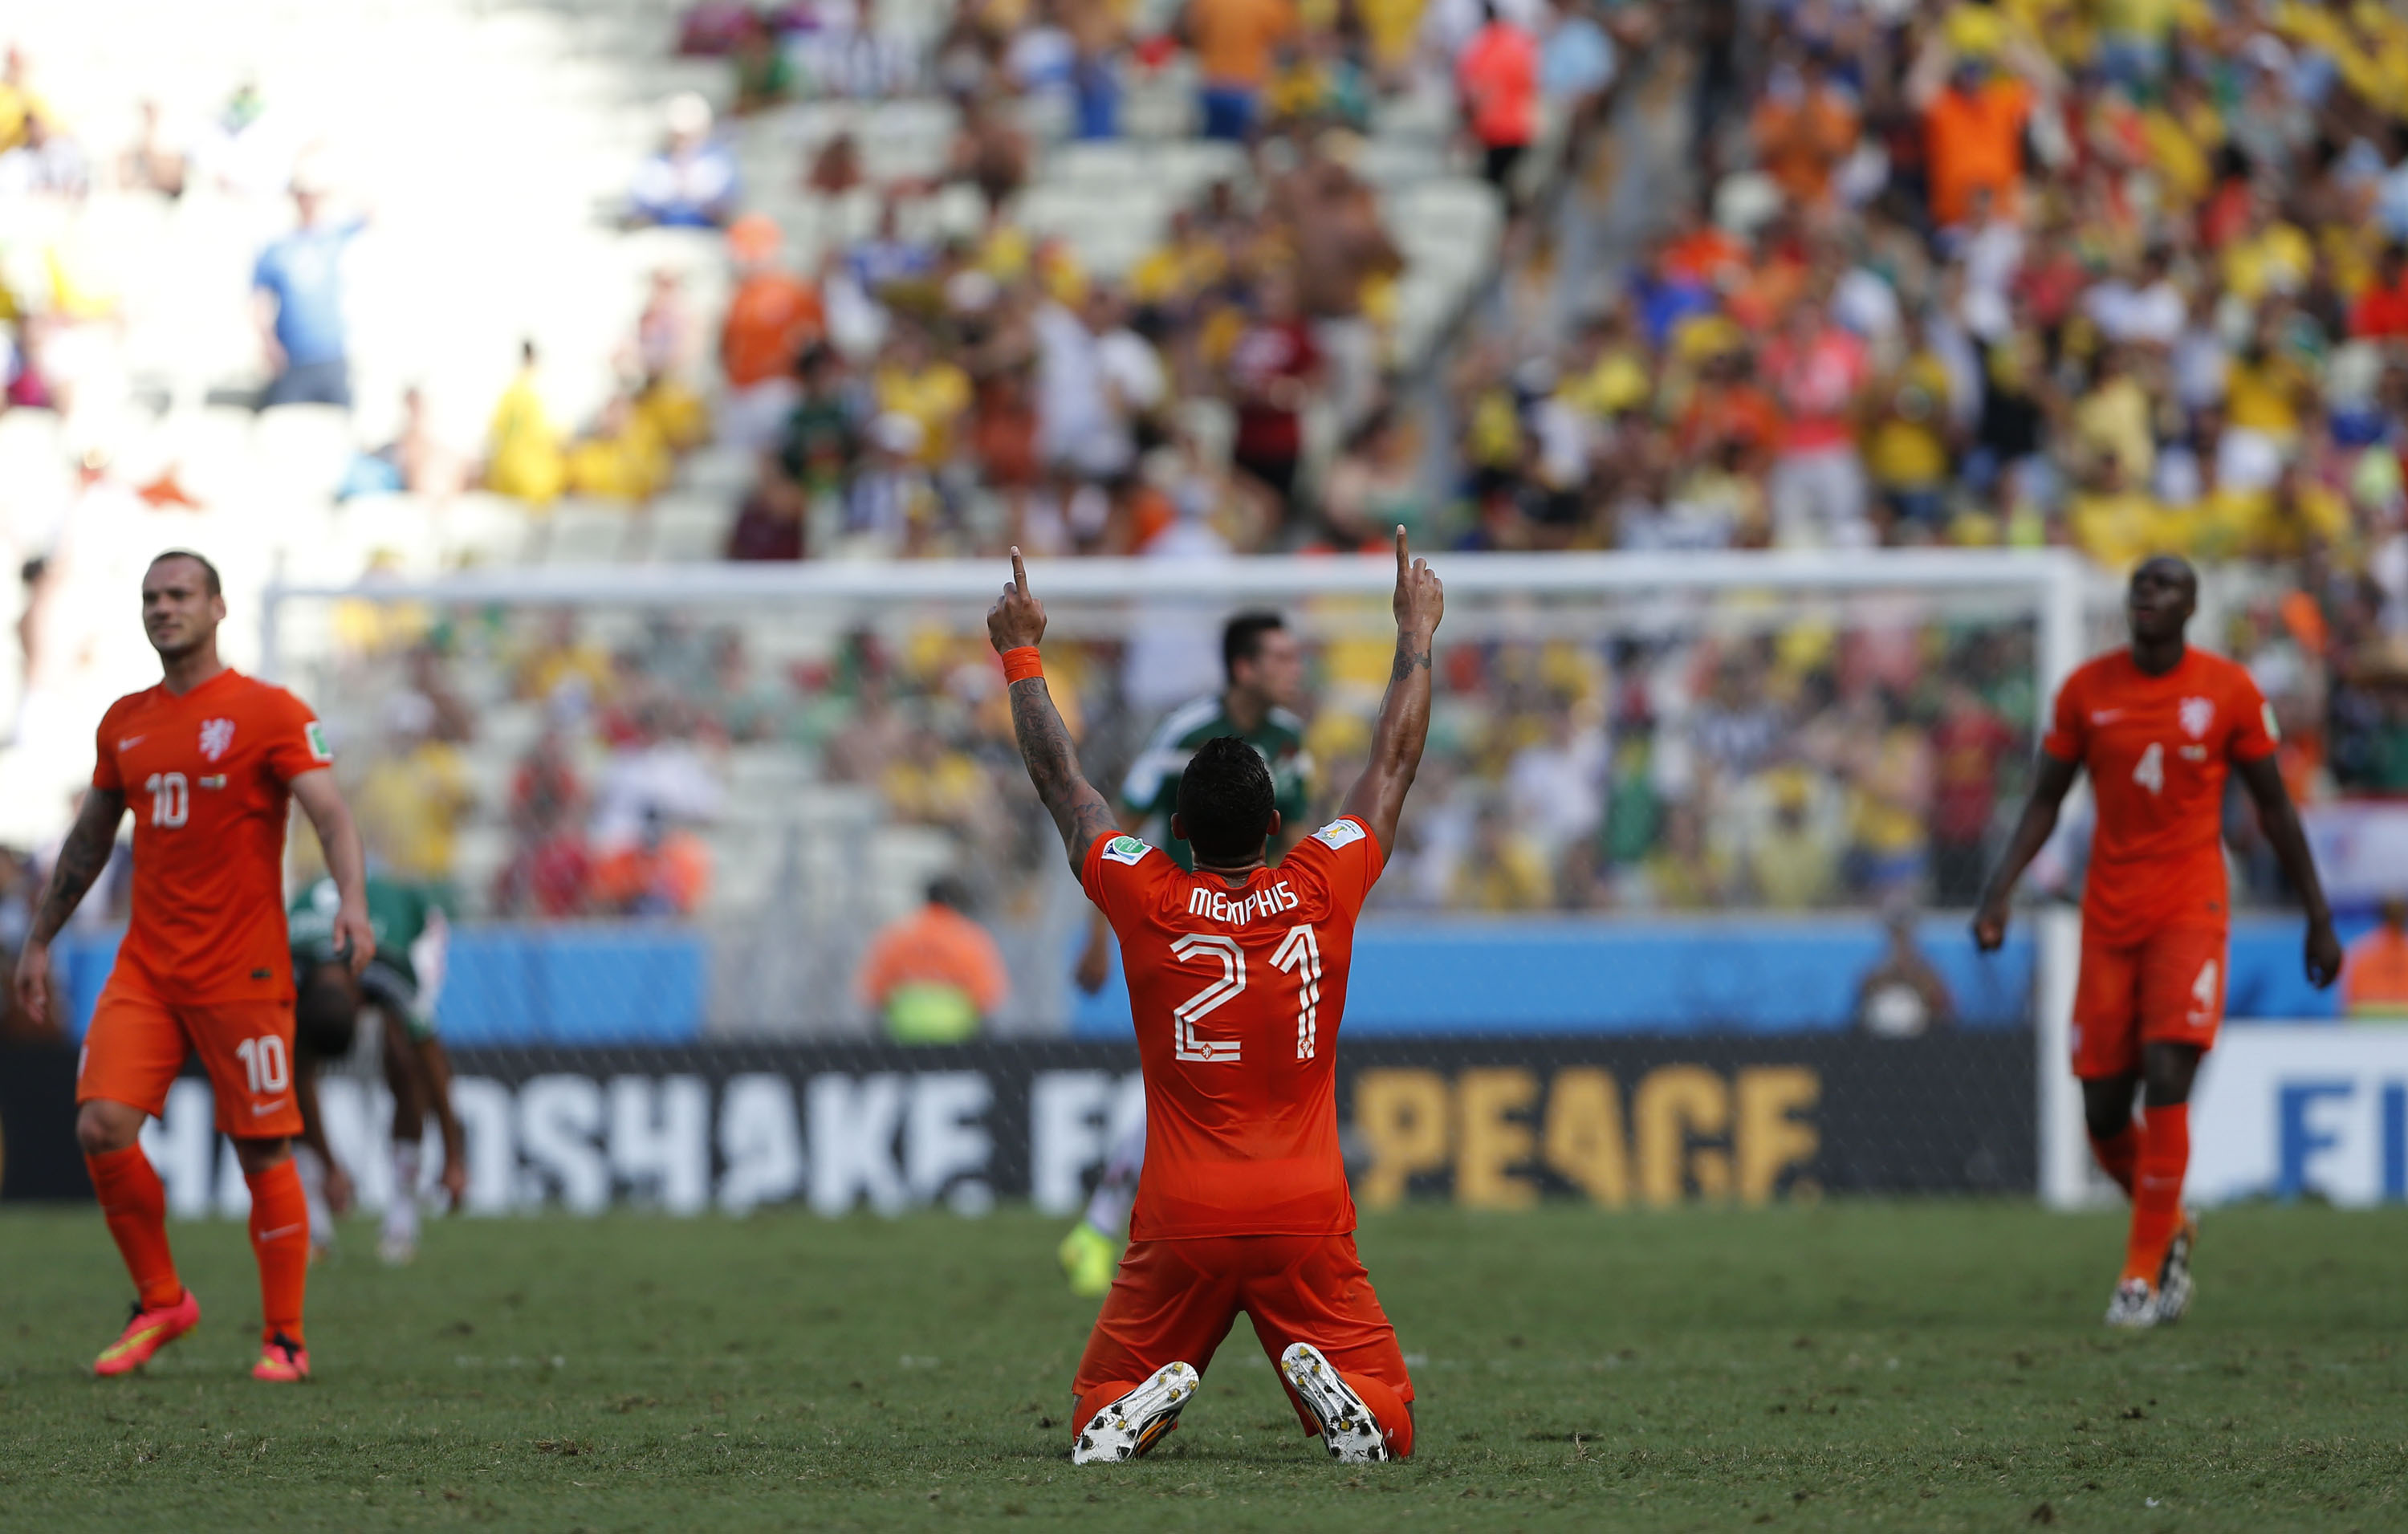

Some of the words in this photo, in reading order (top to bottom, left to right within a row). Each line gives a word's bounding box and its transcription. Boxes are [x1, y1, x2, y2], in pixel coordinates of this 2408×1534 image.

[2133, 742, 2163, 795] 4
[145, 771, 189, 828] 10
[1188, 881, 1299, 926] MEMPHIS
[1169, 923, 1323, 1061] 21
[2192, 958, 2217, 1009] 4
[236, 1035, 289, 1093] 10
[138, 1073, 995, 1218] HNDSHAKE
[1357, 1065, 1822, 1210] PEACE
